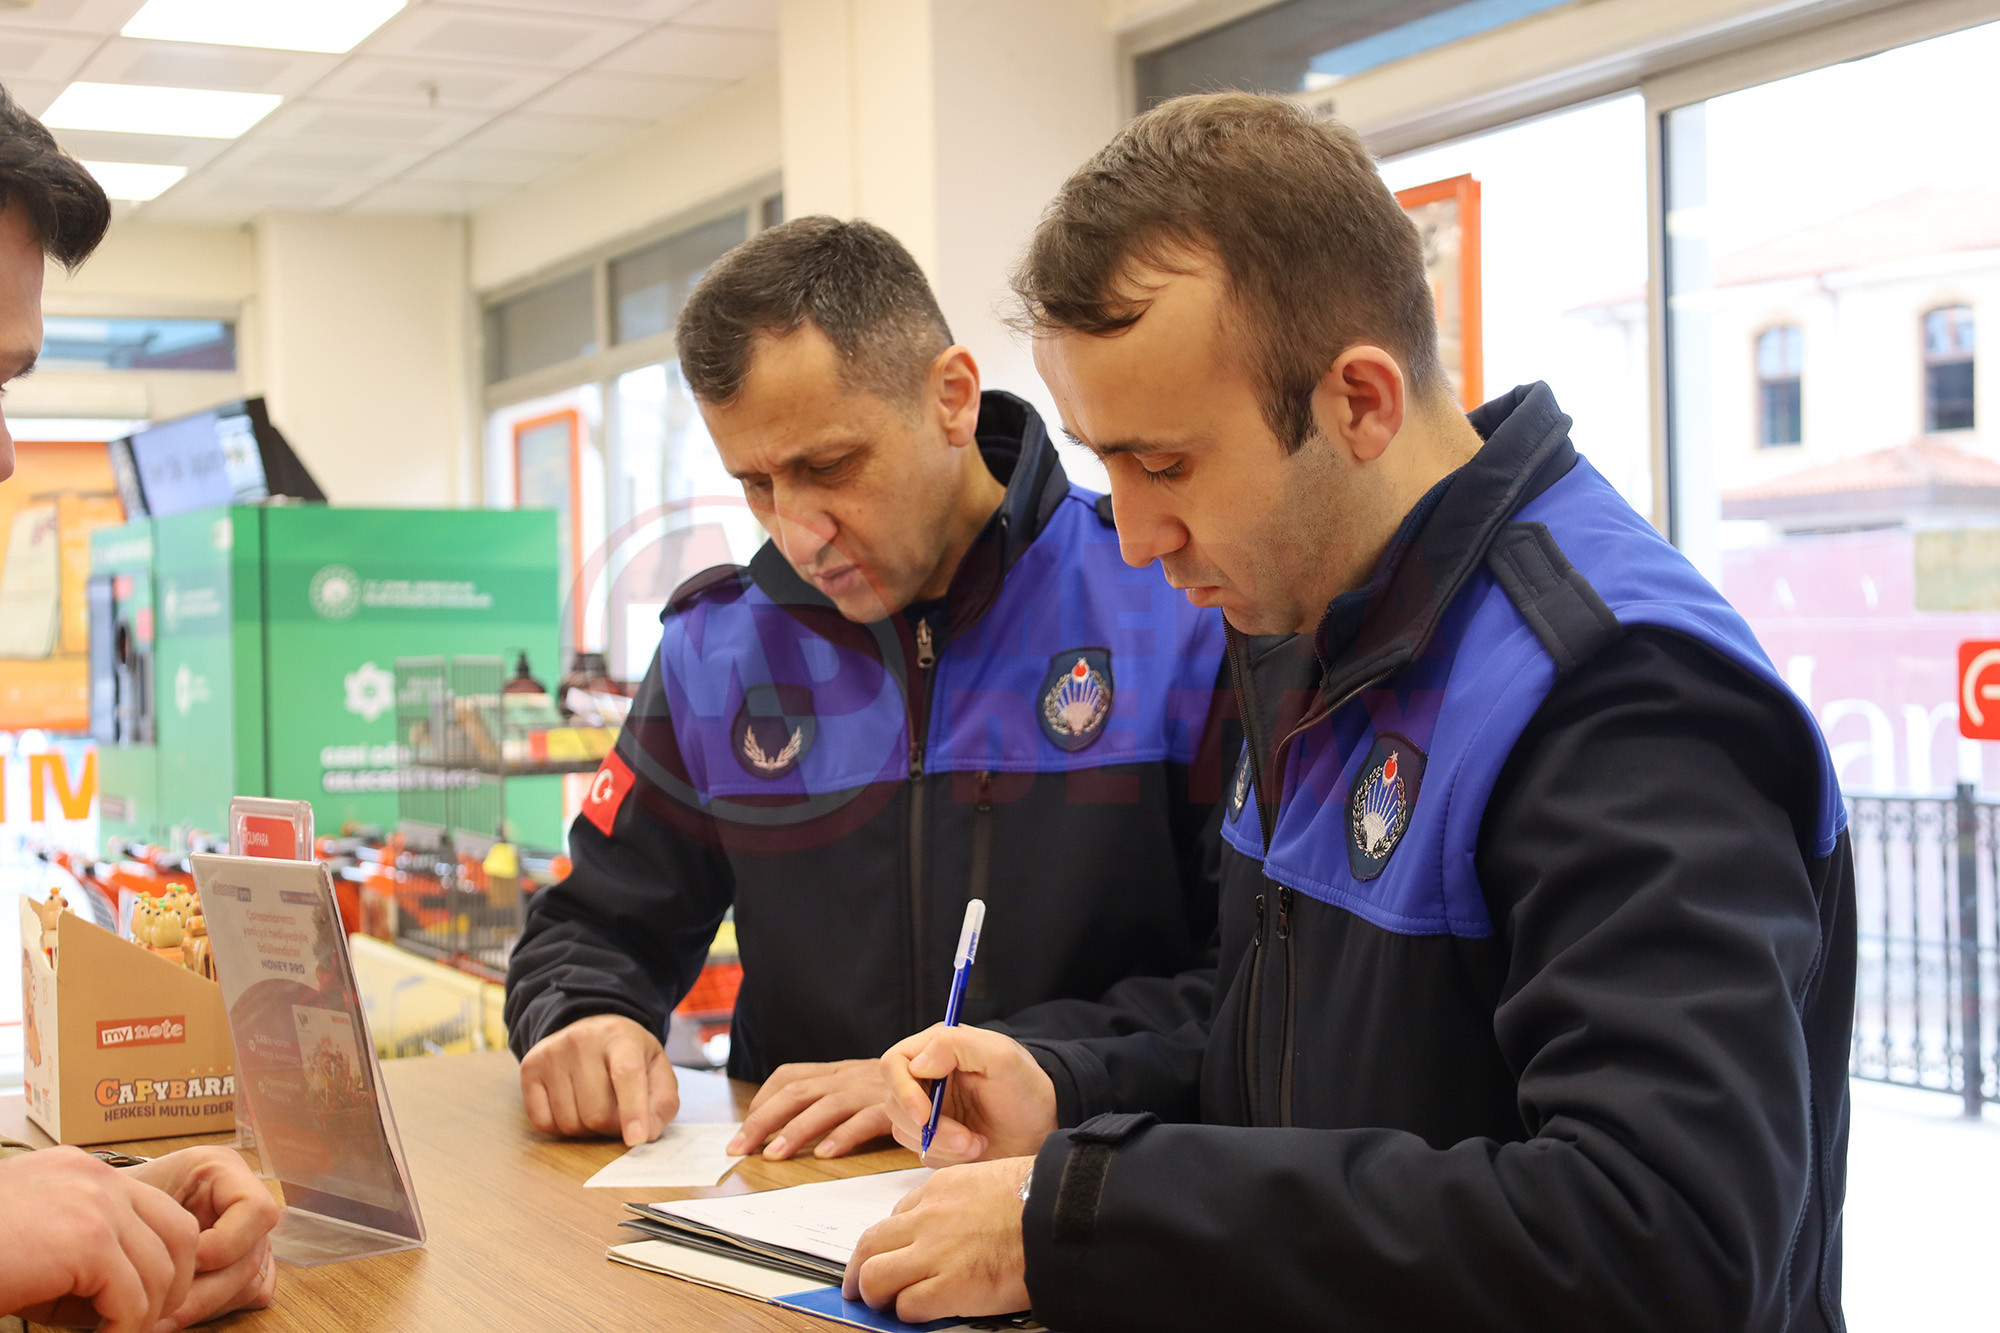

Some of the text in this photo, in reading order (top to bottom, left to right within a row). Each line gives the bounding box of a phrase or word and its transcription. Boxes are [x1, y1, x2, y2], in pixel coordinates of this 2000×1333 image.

[261, 960, 287, 972] MONEY
[104, 1101, 234, 1122] HERKESİ MUTLU EDER
